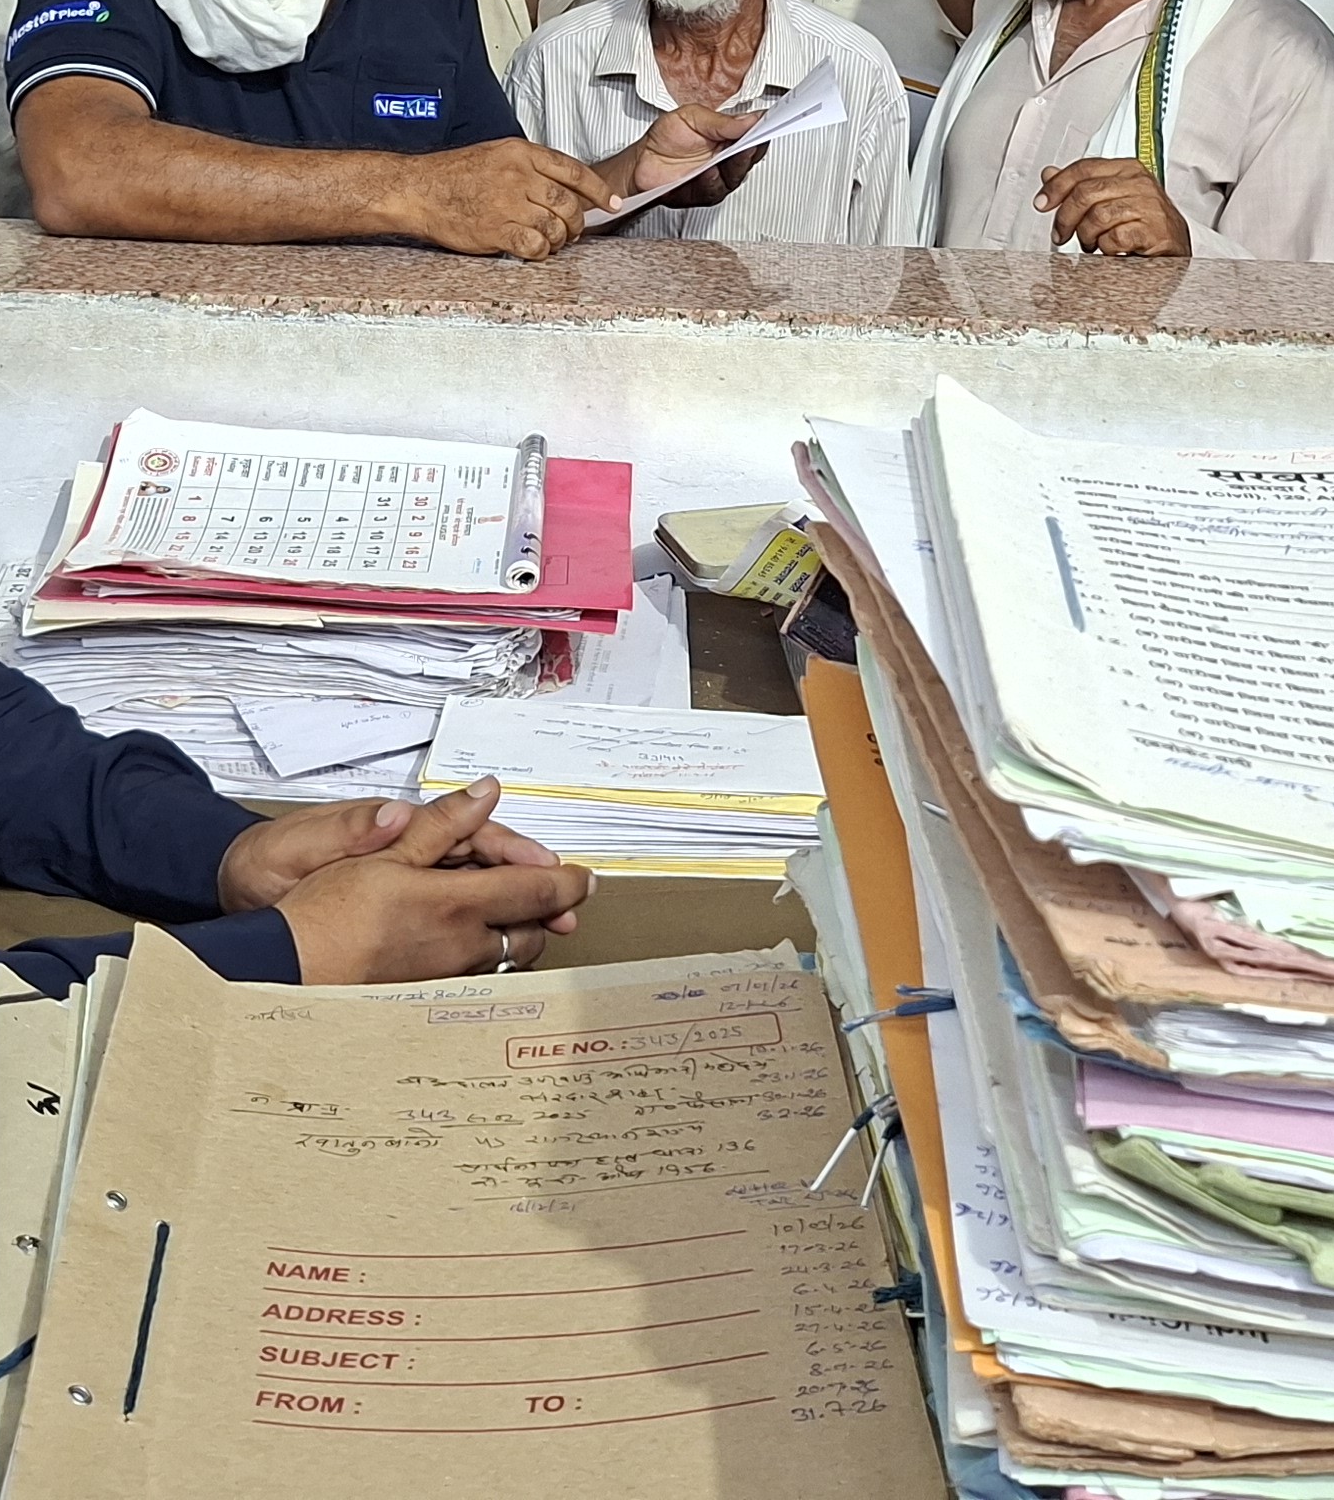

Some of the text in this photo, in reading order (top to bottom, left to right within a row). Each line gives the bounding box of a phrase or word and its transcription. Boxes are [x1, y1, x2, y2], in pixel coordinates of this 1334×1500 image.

[1059, 475, 1141, 490] (General
[1145, 485, 1201, 496] Rules
[1274, 493, 1312, 502] 129,
[377, 496, 392, 508] 31
[415, 496, 429, 507] 30
[174, 531, 192, 541] 15
[214, 531, 231, 540] 14
[253, 531, 269, 541] 13
[292, 531, 308, 541] 12
[331, 531, 347, 541] 11
[369, 530, 385, 541] 10
[209, 545, 224, 553] 21
[248, 545, 264, 555] 20
[287, 546, 304, 555] 19
[326, 546, 342, 555] 18
[366, 546, 382, 556] 17
[405, 546, 421, 556] 16
[363, 560, 378, 569] 24
[402, 560, 418, 570] 23
[16, 568, 33, 578] 28
[516, 1043, 566, 1060] FILE
[571, 1038, 616, 1056] NO.
[266, 1260, 352, 1284] NAME
[260, 1303, 407, 1327] ADDRESS
[258, 1345, 401, 1371] SUBJECT
[254, 1390, 346, 1415] FROM
[524, 1395, 567, 1414] TO
